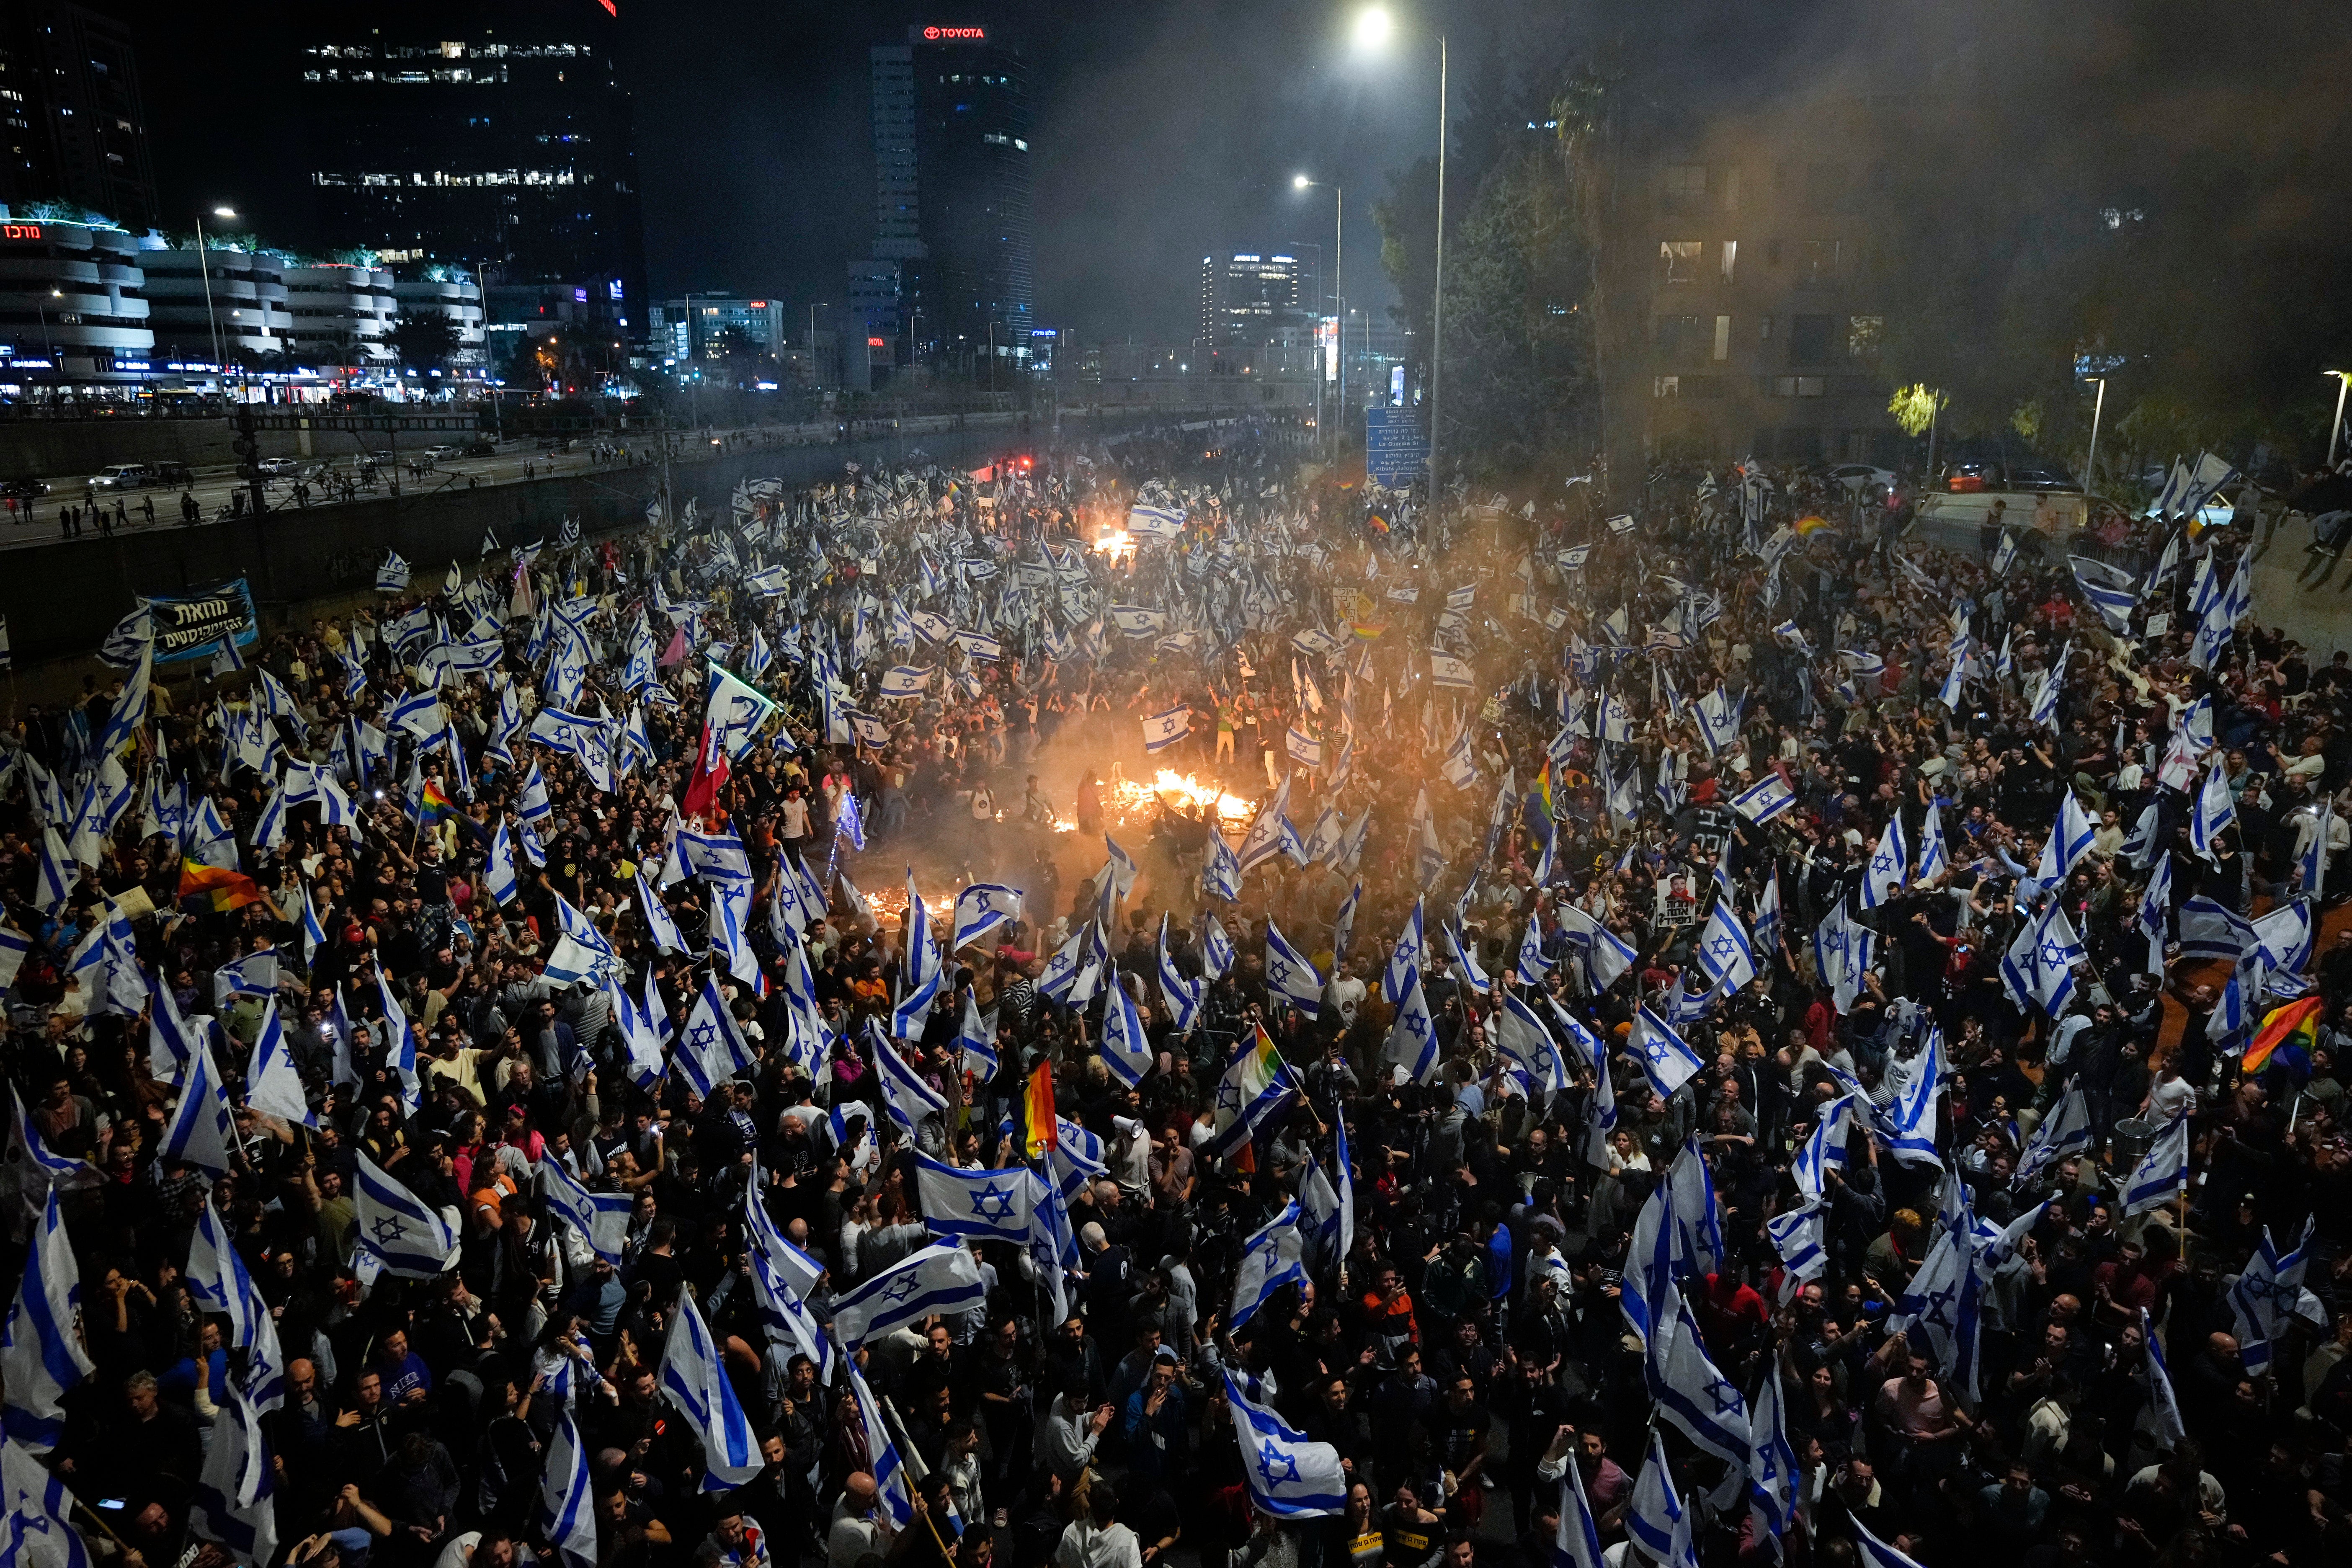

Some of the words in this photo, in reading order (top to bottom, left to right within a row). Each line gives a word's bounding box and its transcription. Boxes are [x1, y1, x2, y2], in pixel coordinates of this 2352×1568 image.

[598, 0, 616, 17] ZUKI
[941, 28, 984, 38] TOYOTA
[3, 226, 40, 238] מרכז
[174, 600, 228, 625] מחאת
[1667, 908, 1689, 916] אתה
[1658, 913, 1692, 925] מפחד?
[1369, 1535, 1382, 1544] שקרן
[1349, 1541, 1363, 1550] שקרן
